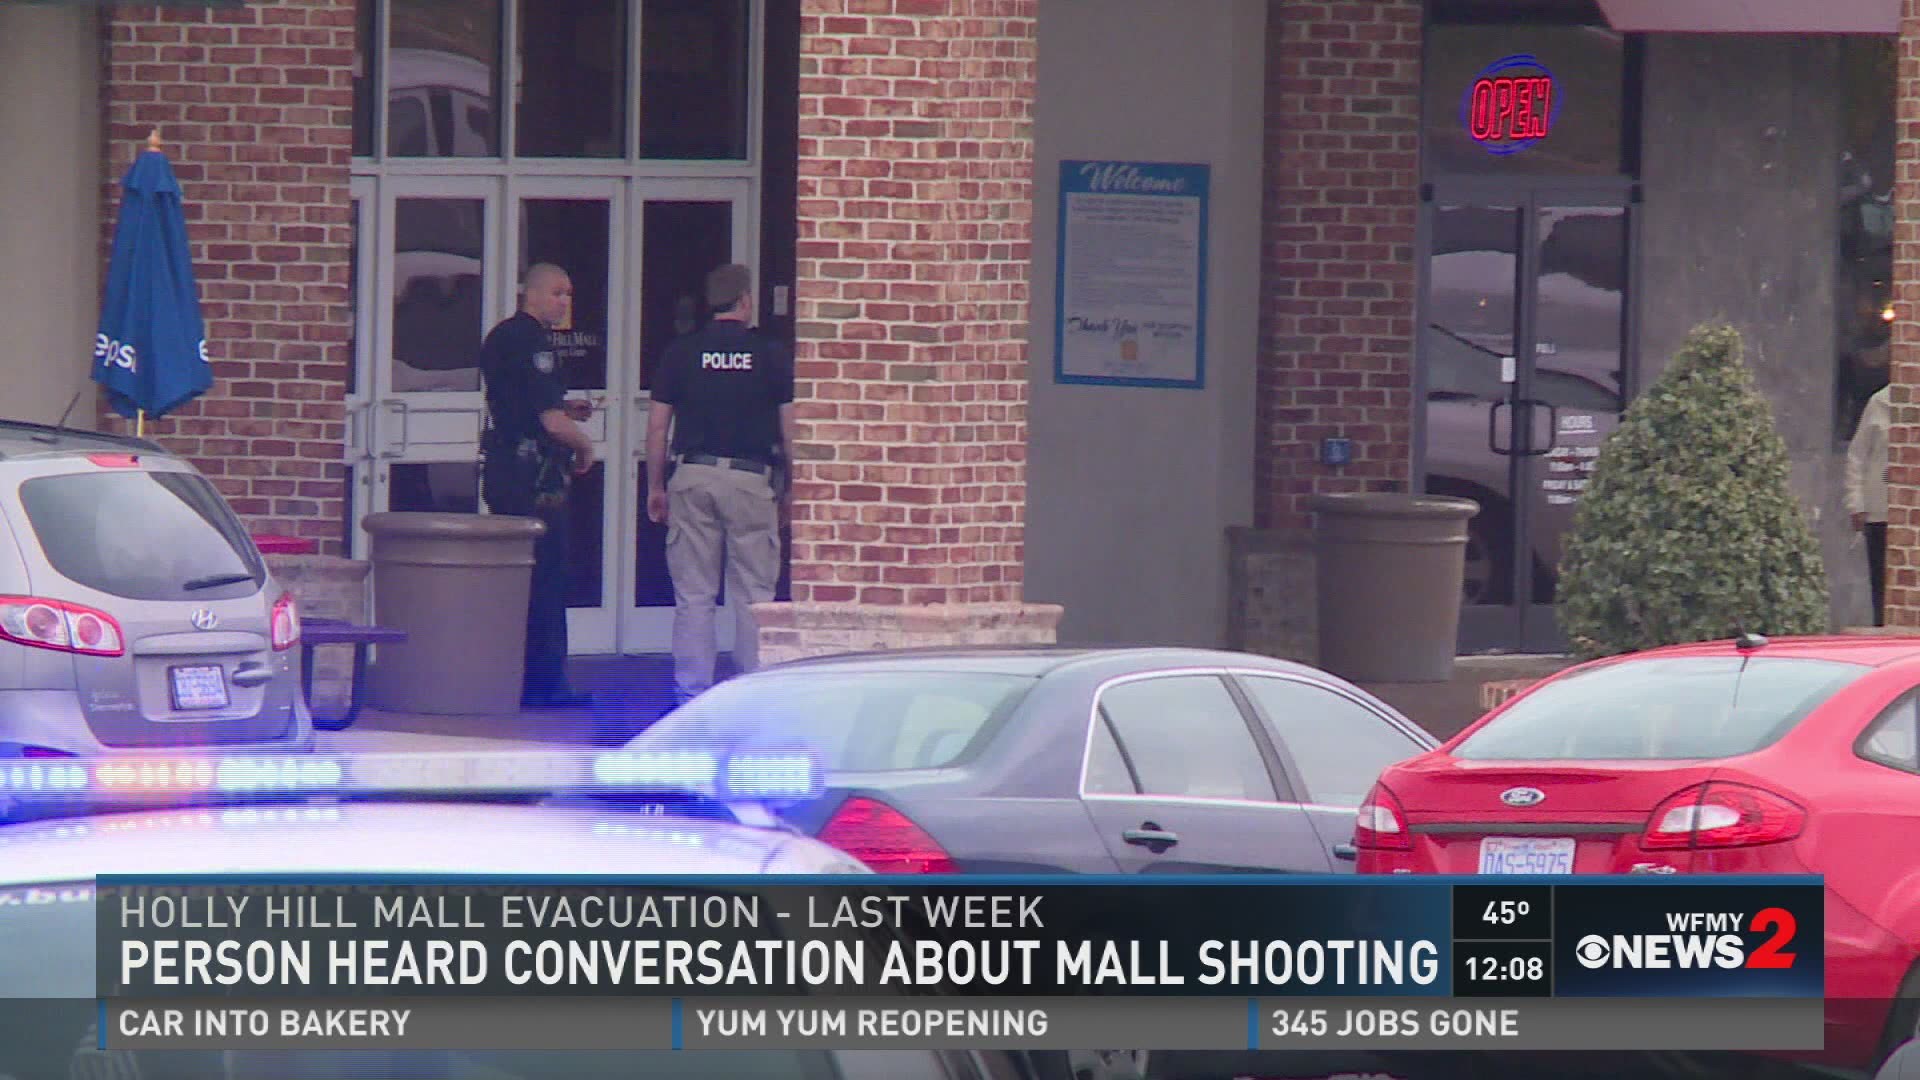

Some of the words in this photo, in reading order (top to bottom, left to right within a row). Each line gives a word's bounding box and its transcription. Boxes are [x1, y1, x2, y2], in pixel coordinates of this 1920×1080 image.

[1472, 79, 1551, 139] OPEN
[1080, 162, 1185, 192] Welcome
[702, 352, 752, 370] POLICE
